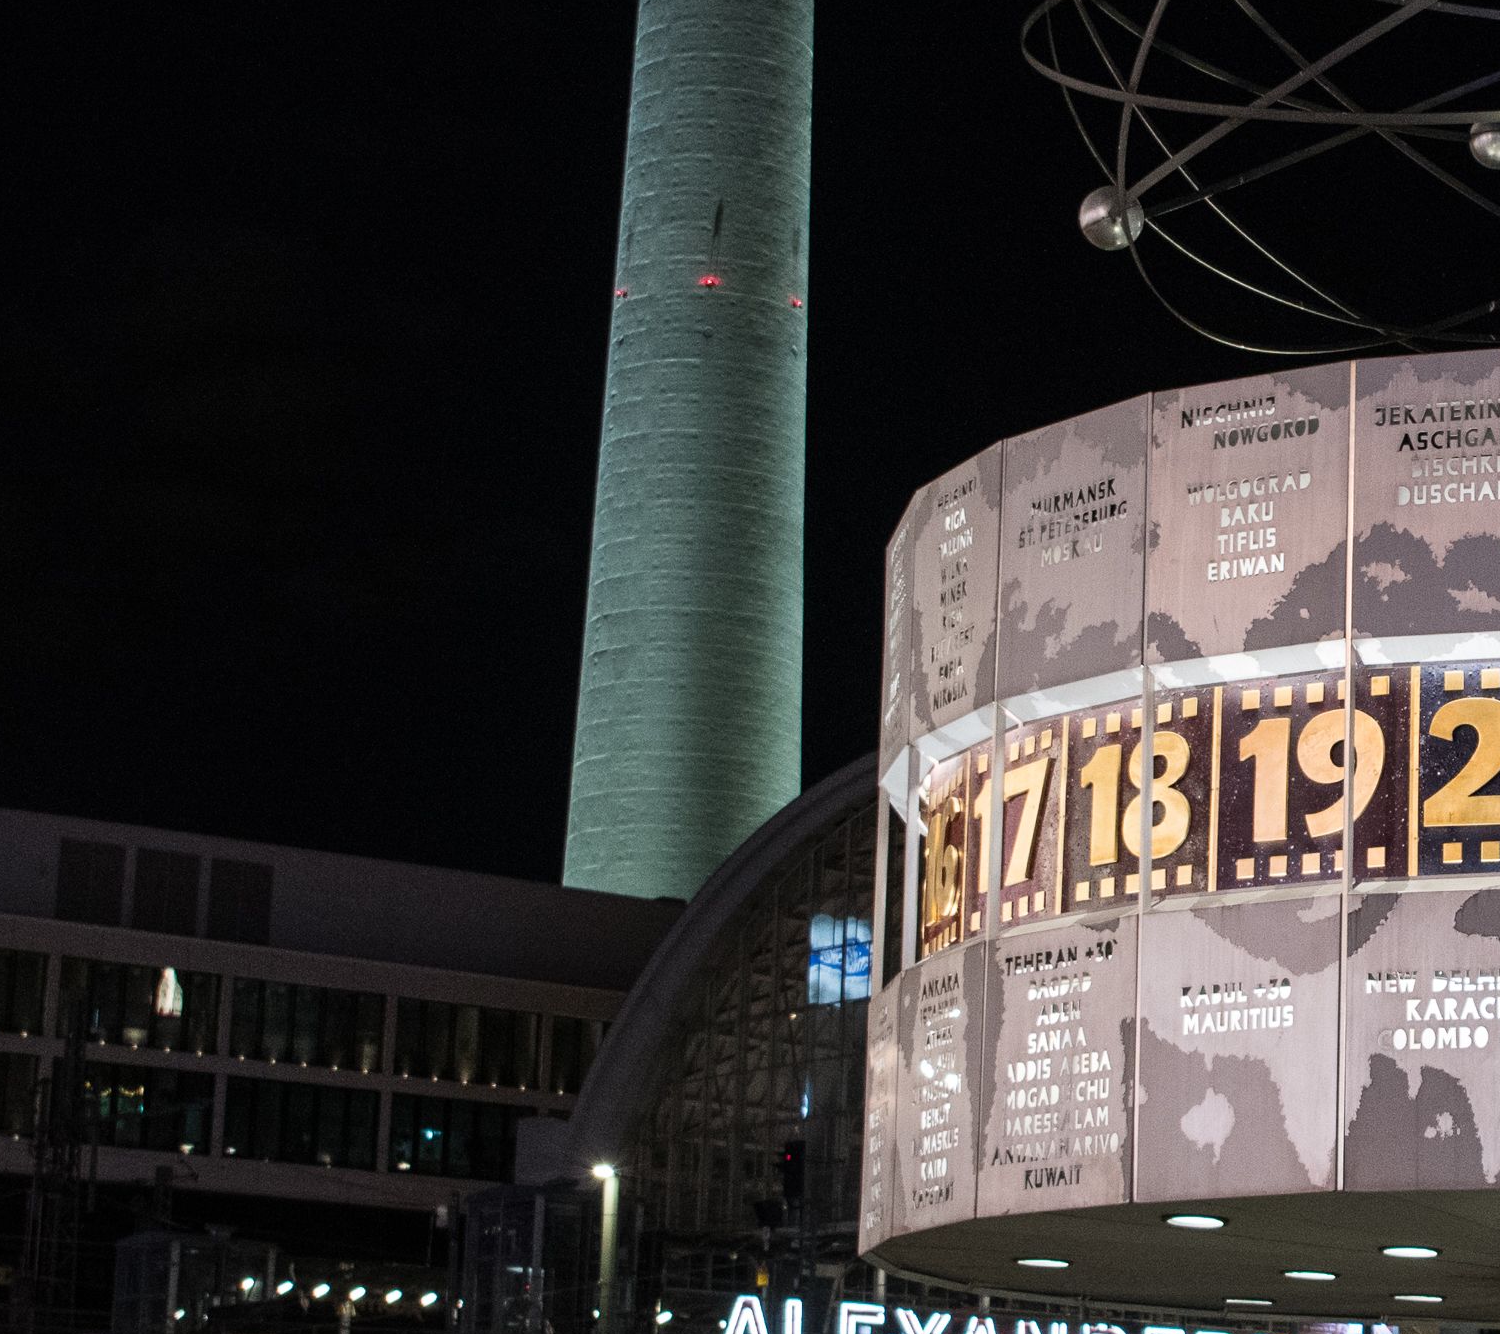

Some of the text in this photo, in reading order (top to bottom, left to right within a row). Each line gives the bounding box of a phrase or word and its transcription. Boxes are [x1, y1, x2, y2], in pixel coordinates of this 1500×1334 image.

[1181, 396, 1275, 428] NISCHNIJ
[1213, 415, 1320, 450] NOWGOROD
[1032, 478, 1116, 519] MURMANSK
[1187, 470, 1311, 506] WOLGOGRAD
[944, 508, 967, 532] RIGA
[1220, 501, 1274, 528] BAKU
[1040, 533, 1103, 568] MOSKAU
[1217, 527, 1277, 555] TIFLIS
[1207, 552, 1286, 582] ERIWAN
[939, 581, 968, 609] MINSK
[932, 682, 968, 712] NIKOSIA
[1240, 708, 1387, 843] 19
[1080, 731, 1192, 867] 18
[974, 756, 1053, 894] 17
[1005, 945, 1078, 976] TEHERAN
[920, 973, 960, 1002] ANKARA
[1027, 971, 1092, 1001] BAGDAD
[1180, 982, 1248, 1008] KABUL
[1365, 970, 1417, 994] NEW
[1035, 1000, 1082, 1028] ADEN
[1183, 1005, 1294, 1036] MAURITIUS
[1027, 1026, 1087, 1055] SANAA
[1377, 1025, 1489, 1051] COLOMBO
[1006, 1050, 1112, 1083] ADDIS ABEBA
[920, 1102, 951, 1131] BEIRUT
[991, 1132, 1120, 1167] ANTANANARIVO
[920, 1157, 948, 1182] KAIRO
[1024, 1164, 1083, 1191] KUWAIT
